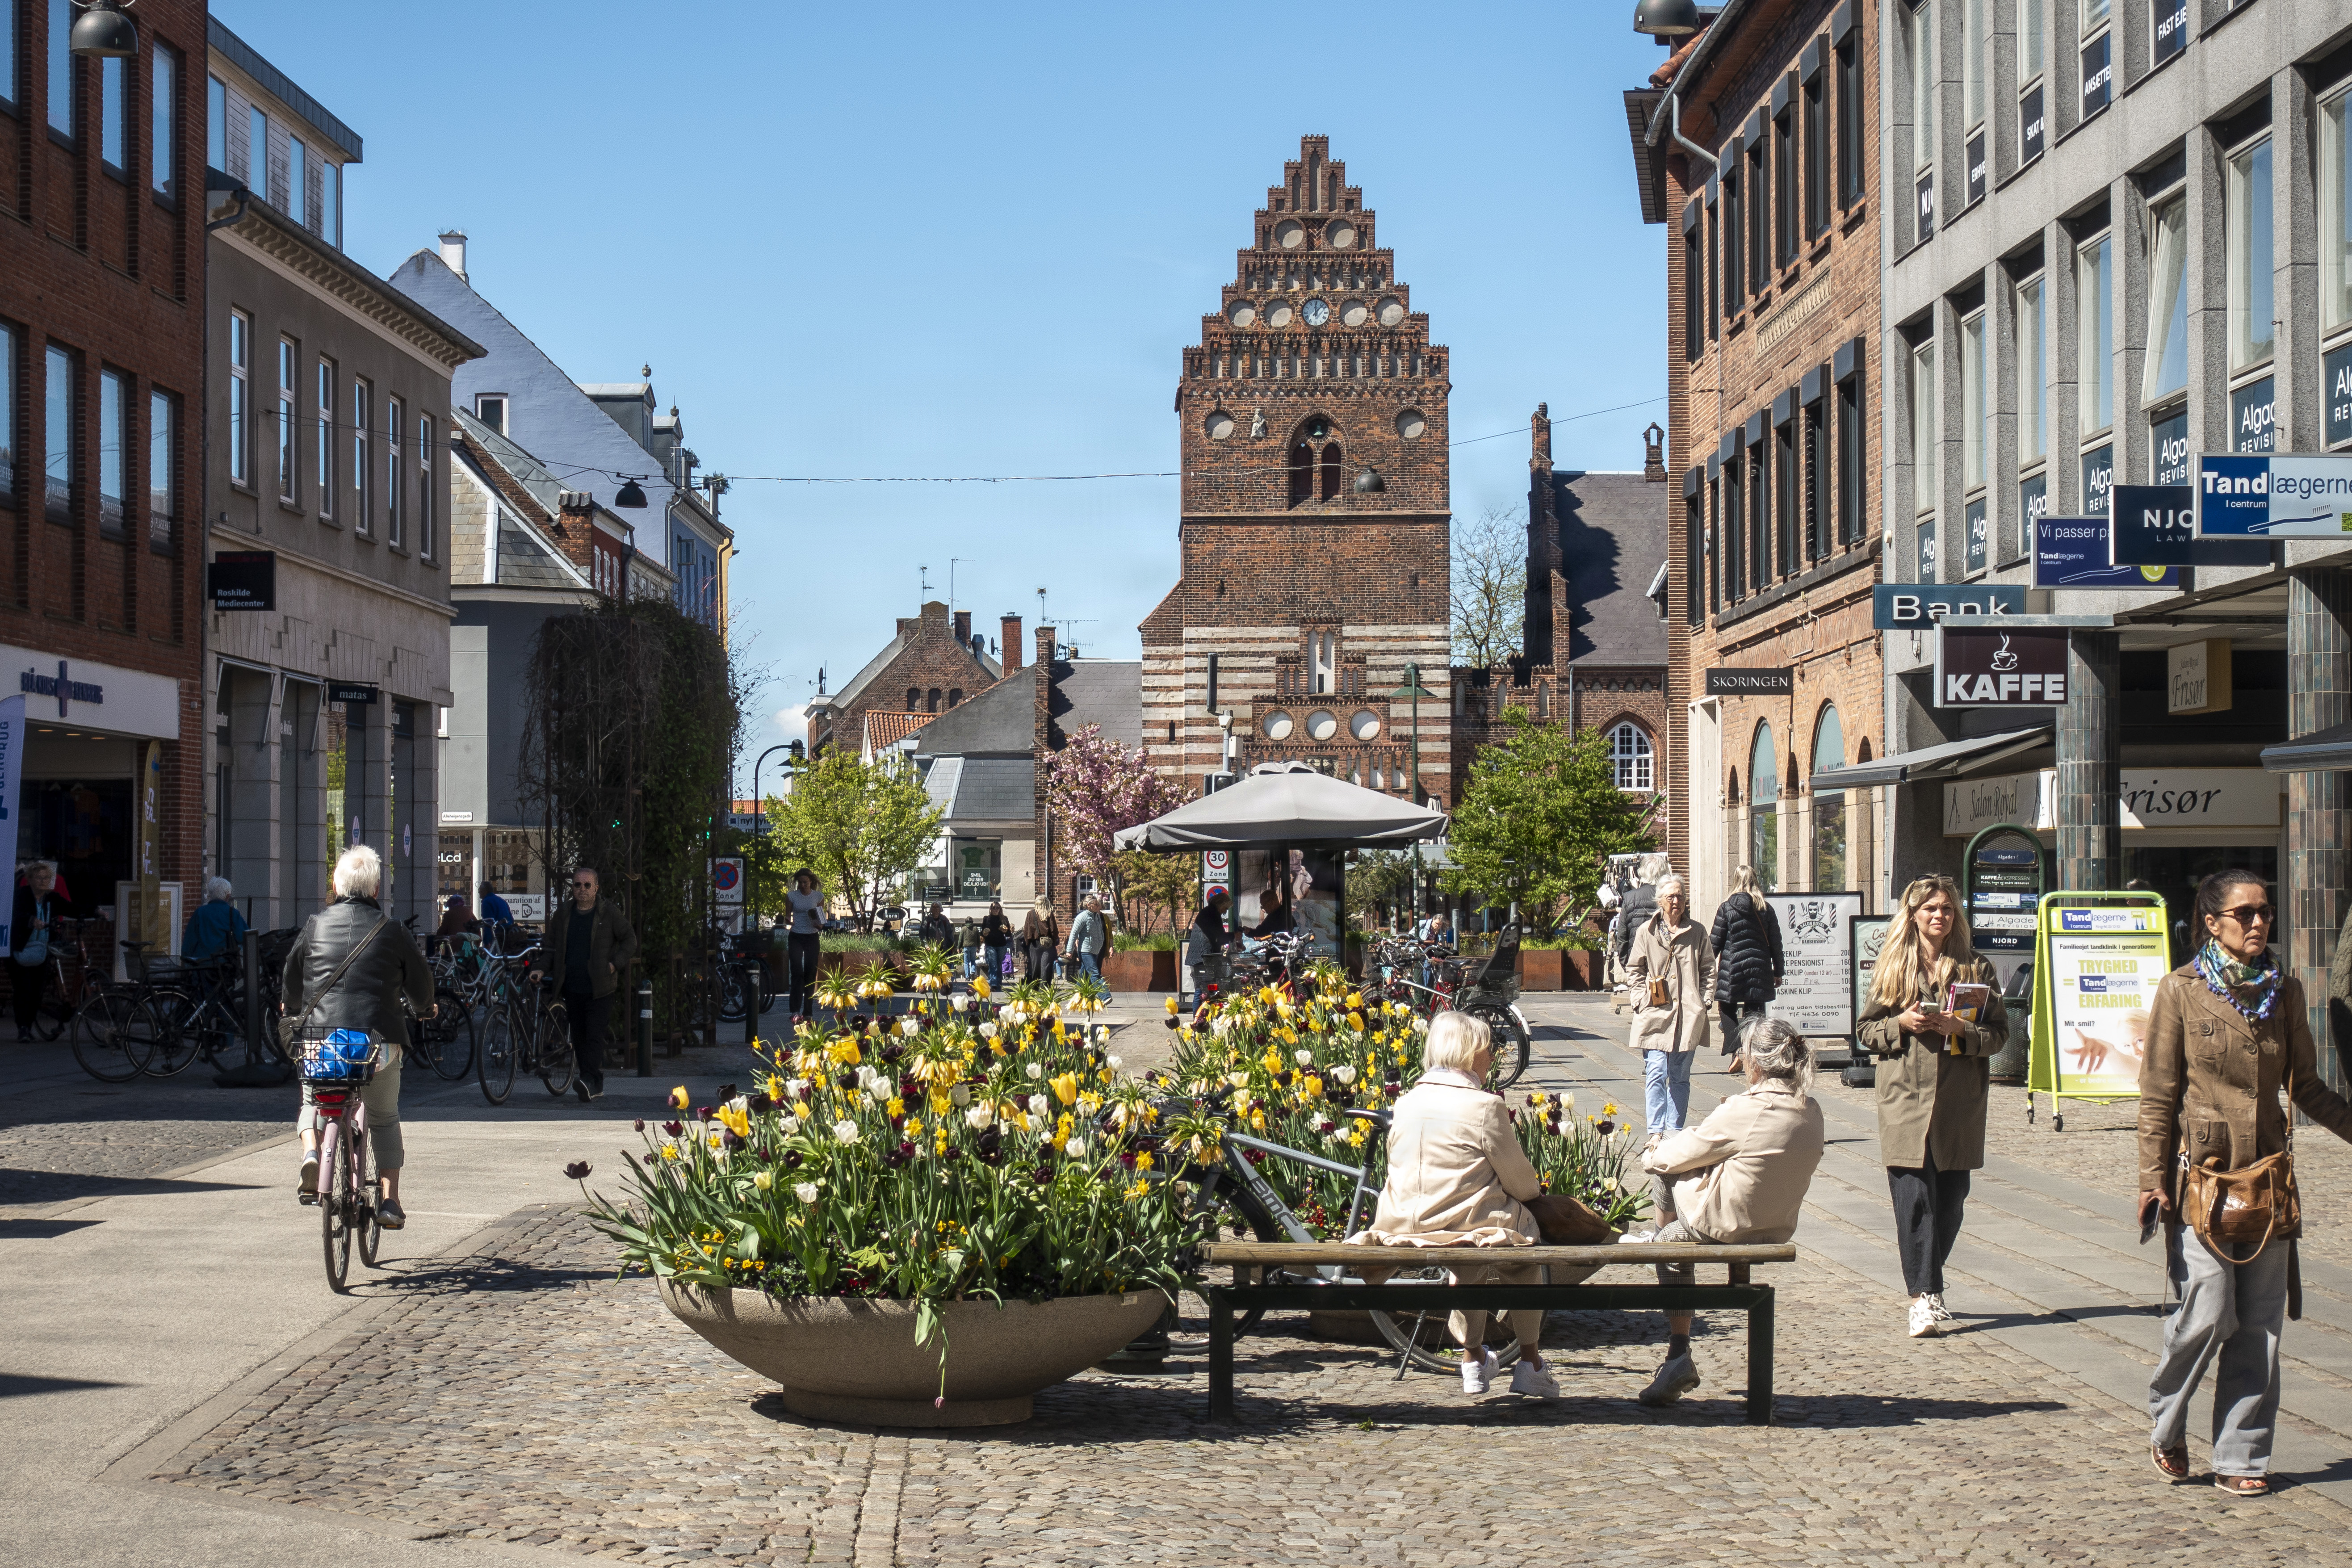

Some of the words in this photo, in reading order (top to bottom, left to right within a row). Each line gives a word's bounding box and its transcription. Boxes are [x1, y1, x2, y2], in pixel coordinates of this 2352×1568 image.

[2158, 16, 2174, 41] FAST
[2027, 119, 2040, 141] SKAT
[2230, 500, 2267, 508] centrum
[2040, 525, 2050, 537] Vi
[2055, 527, 2095, 541] passer
[1972, 541, 1986, 556] REVI
[2040, 553, 2084, 561] Tandlægerne
[1892, 595, 2011, 620] Bank
[1713, 675, 1788, 688] SKORINGEN
[1947, 674, 2064, 701] KAFFE
[339, 691, 367, 700] matas
[2172, 671, 2205, 707] Frisør
[1970, 783, 1992, 822] Salon
[1994, 779, 2018, 823] Royal
[2120, 779, 2222, 814] risør
[740, 817, 753, 826] nyt
[1211, 853, 1225, 862] 30
[2065, 913, 2126, 922] Tandlægerne
[2078, 960, 2138, 973] TRYGHED
[2083, 978, 2138, 987] Tandlægerne
[2079, 994, 2142, 1008] ERFARING
[1251, 1176, 1299, 1231] BMC
